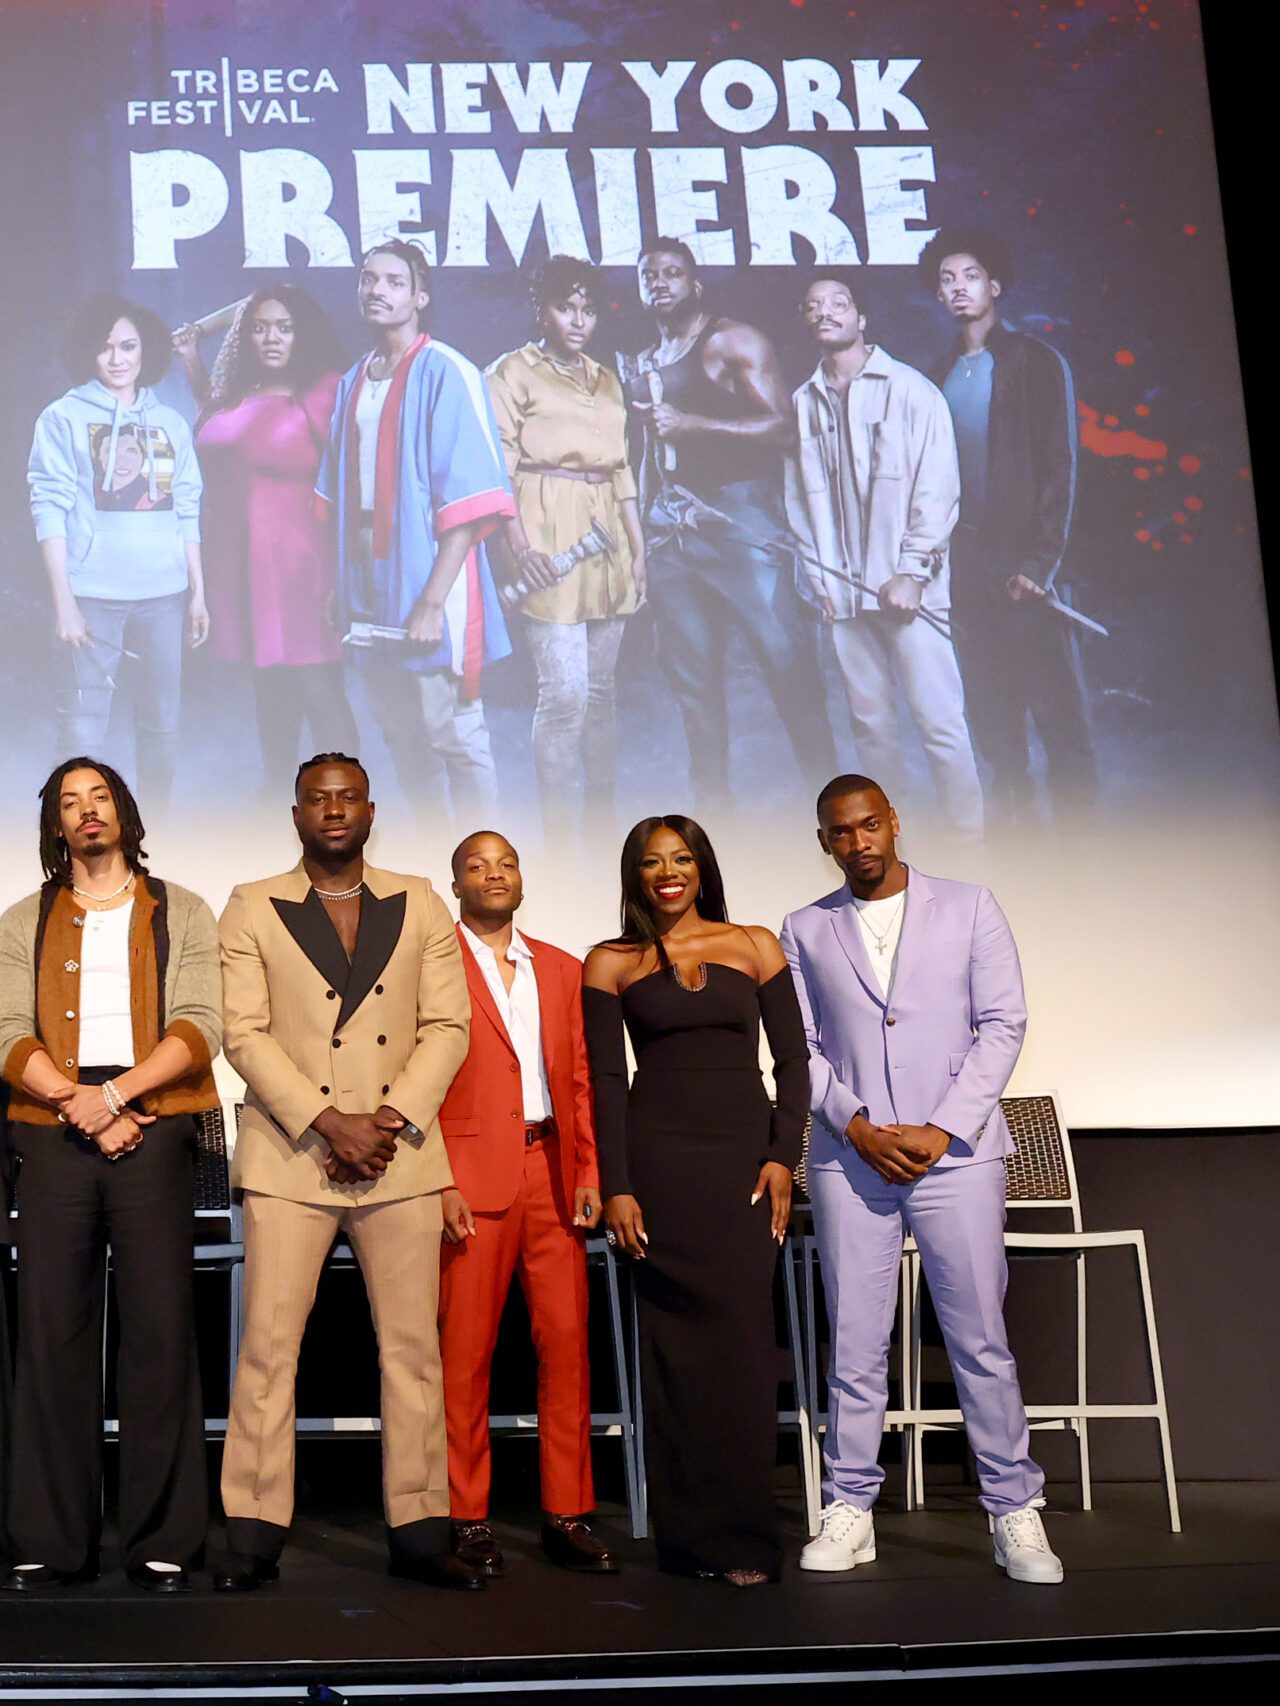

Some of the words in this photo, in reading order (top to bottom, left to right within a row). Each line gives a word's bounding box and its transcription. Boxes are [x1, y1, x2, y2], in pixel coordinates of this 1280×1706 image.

[363, 62, 591, 134] NEW
[621, 59, 928, 133] YORK
[130, 146, 941, 270] PREMIERE
